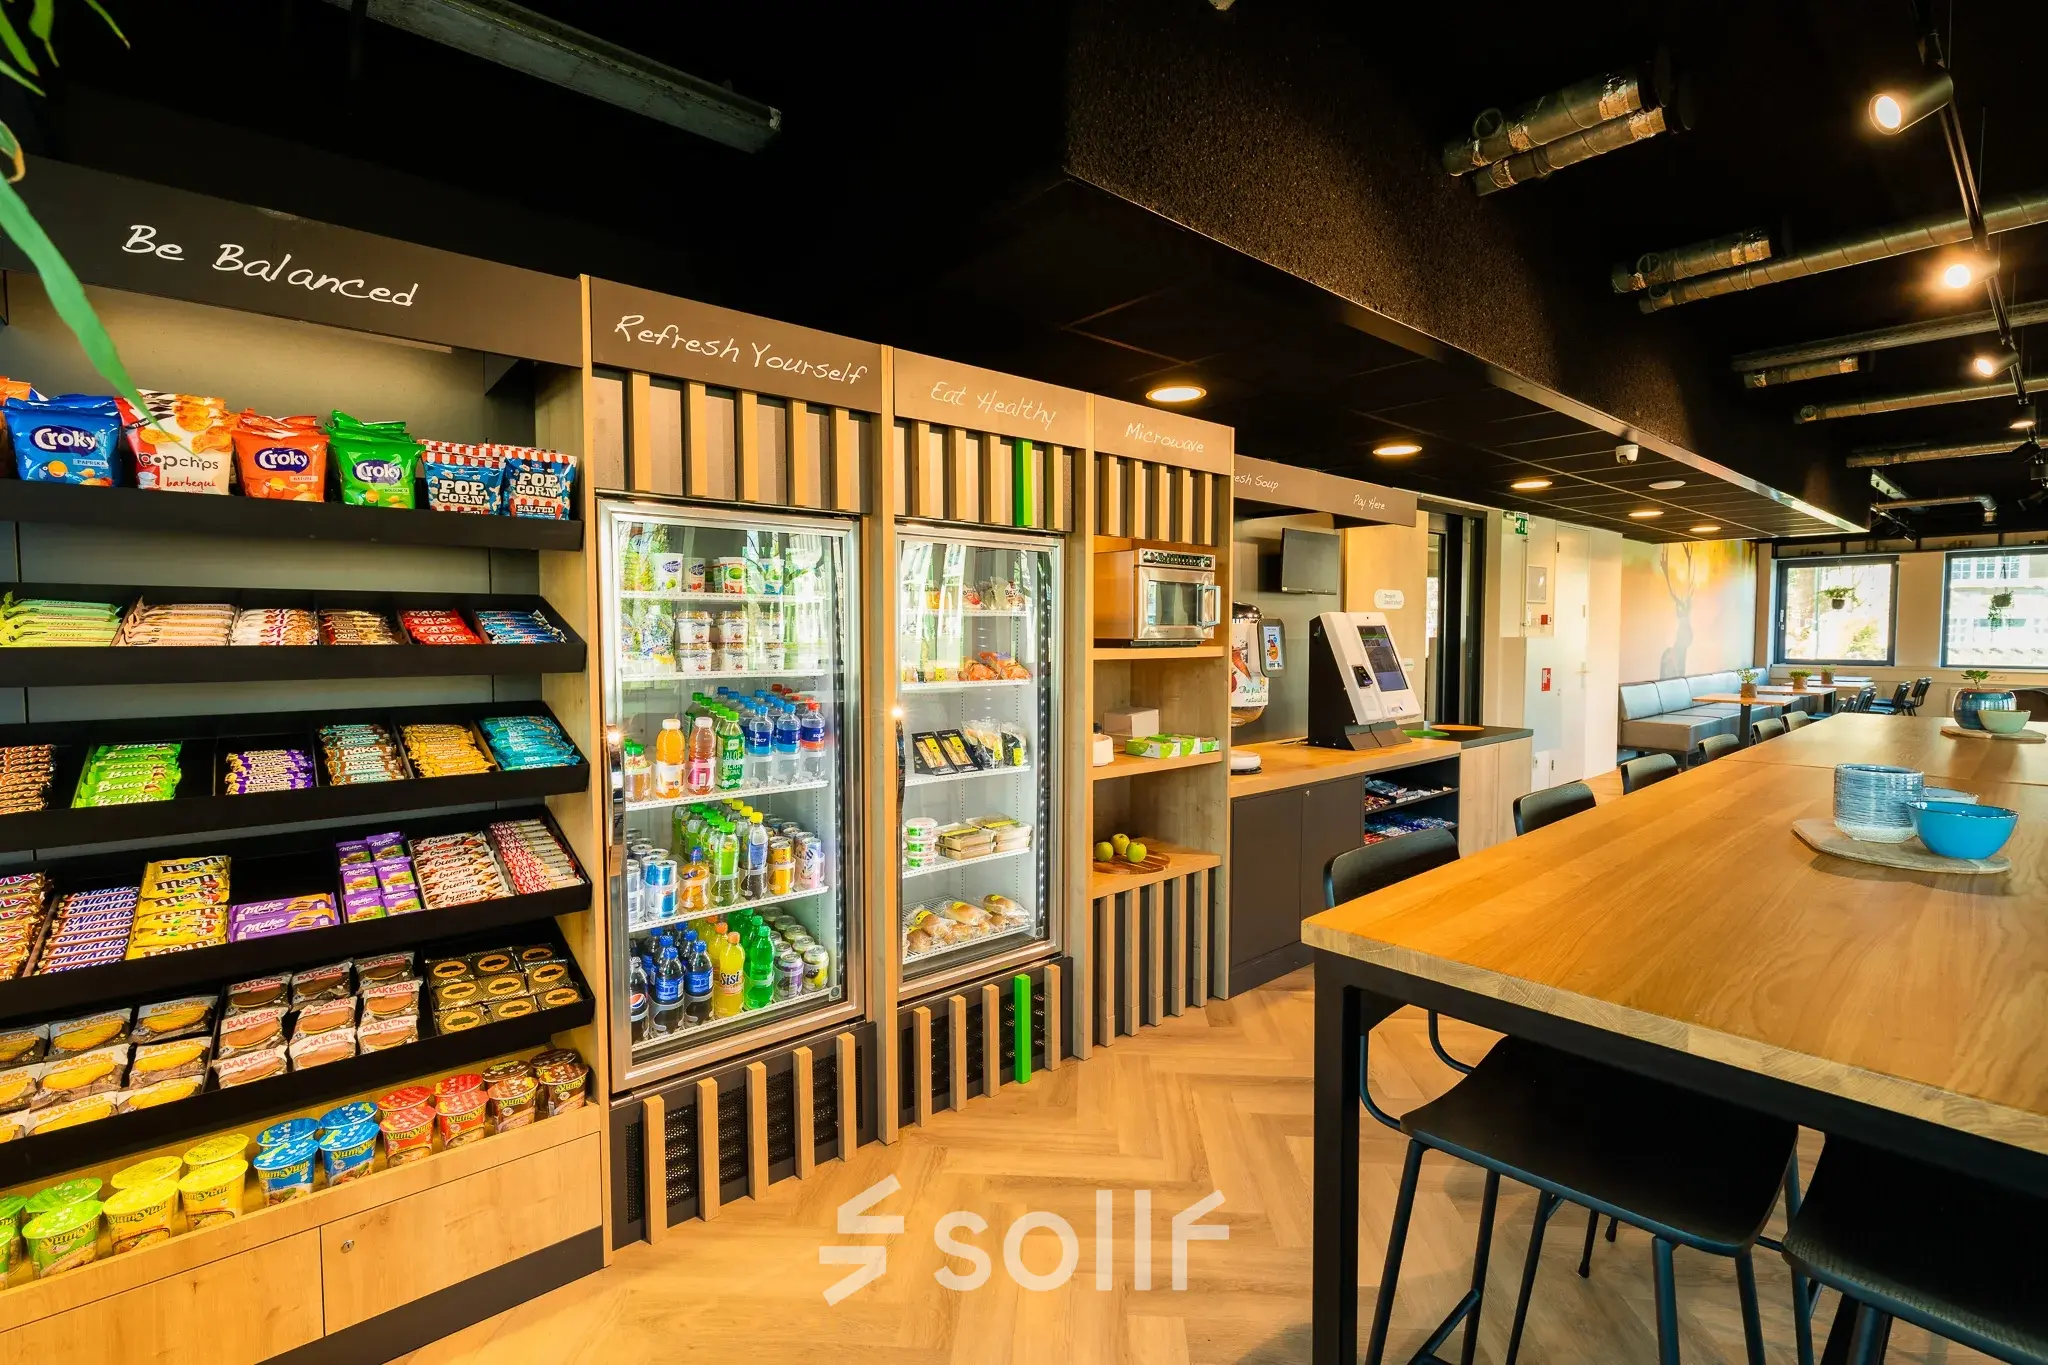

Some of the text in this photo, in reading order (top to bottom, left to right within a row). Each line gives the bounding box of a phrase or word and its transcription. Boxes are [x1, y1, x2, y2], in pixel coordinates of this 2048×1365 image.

[122, 224, 419, 308] Be Balanced
[614, 314, 868, 385] Refresh Yourself
[930, 381, 1058, 431] Eat Healthy
[34, 428, 97, 451] Croky
[1124, 421, 1205, 454] Microwave
[138, 451, 219, 471] popchips
[258, 450, 308, 469] Croky
[356, 461, 401, 482] Croky
[519, 472, 559, 488] POP
[439, 479, 485, 496] POP
[516, 484, 559, 498] CORN
[1233, 472, 1279, 493] esh Soup
[438, 493, 485, 505] CORN
[1353, 494, 1386, 511] Pay Here
[516, 504, 554, 514] SALTED
[725, 750, 742, 761] ALOE
[68, 900, 136, 915] SNICKERS
[69, 892, 138, 908] SNICKERS
[239, 901, 285, 915] Milka
[65, 909, 134, 927] SNICKERS
[240, 917, 287, 933] Milka
[57, 928, 130, 943] SNICKERS
[54, 939, 127, 955] SNICKERS
[51, 947, 125, 965] SNICKERS
[720, 971, 740, 986] Sisi
[368, 982, 414, 995] BAKKERS
[226, 1008, 280, 1030] BAKKERS
